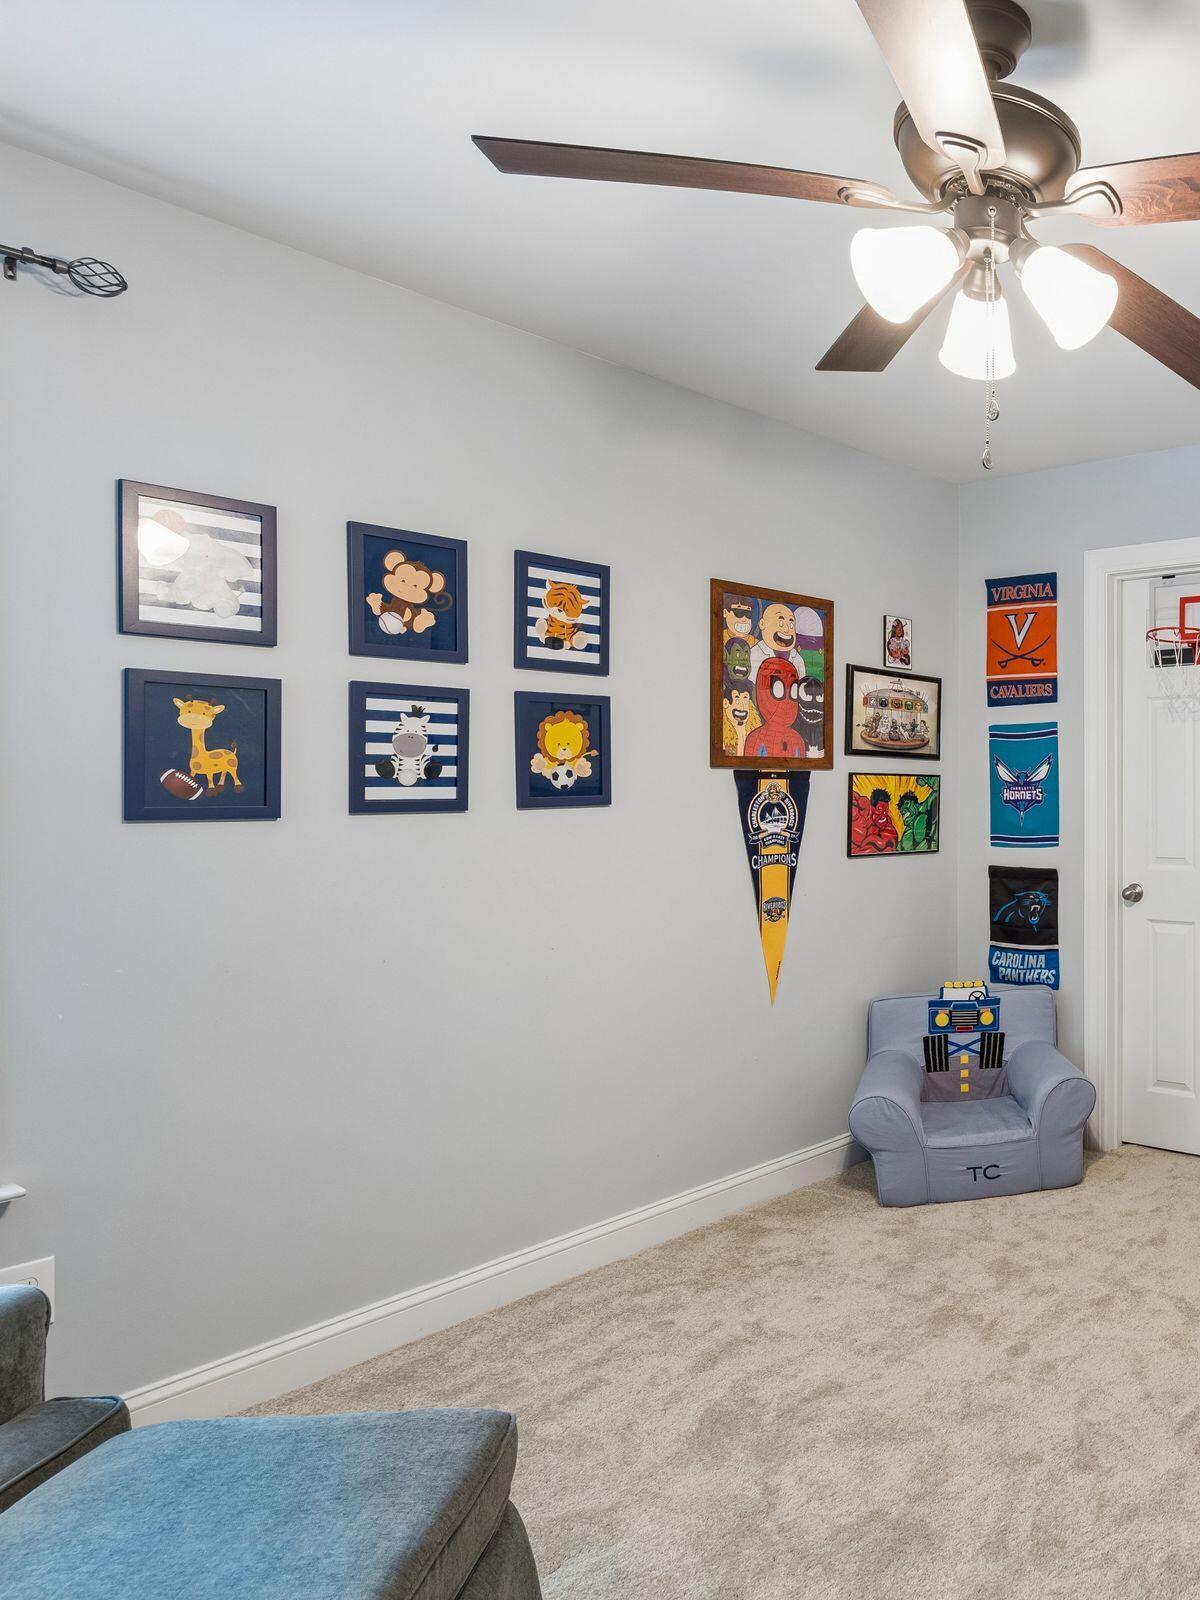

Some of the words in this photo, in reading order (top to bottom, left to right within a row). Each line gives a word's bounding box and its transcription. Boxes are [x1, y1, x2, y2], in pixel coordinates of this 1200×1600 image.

[992, 583, 1053, 602] VIRGINIA
[990, 683, 1053, 699] CAVALIERS
[1003, 788, 1042, 800] HORNETS
[752, 853, 797, 869] CHAMPIONS
[992, 950, 1045, 969] CAROLINA
[998, 966, 1056, 985] PANTHERS
[966, 1164, 1002, 1181] TC
